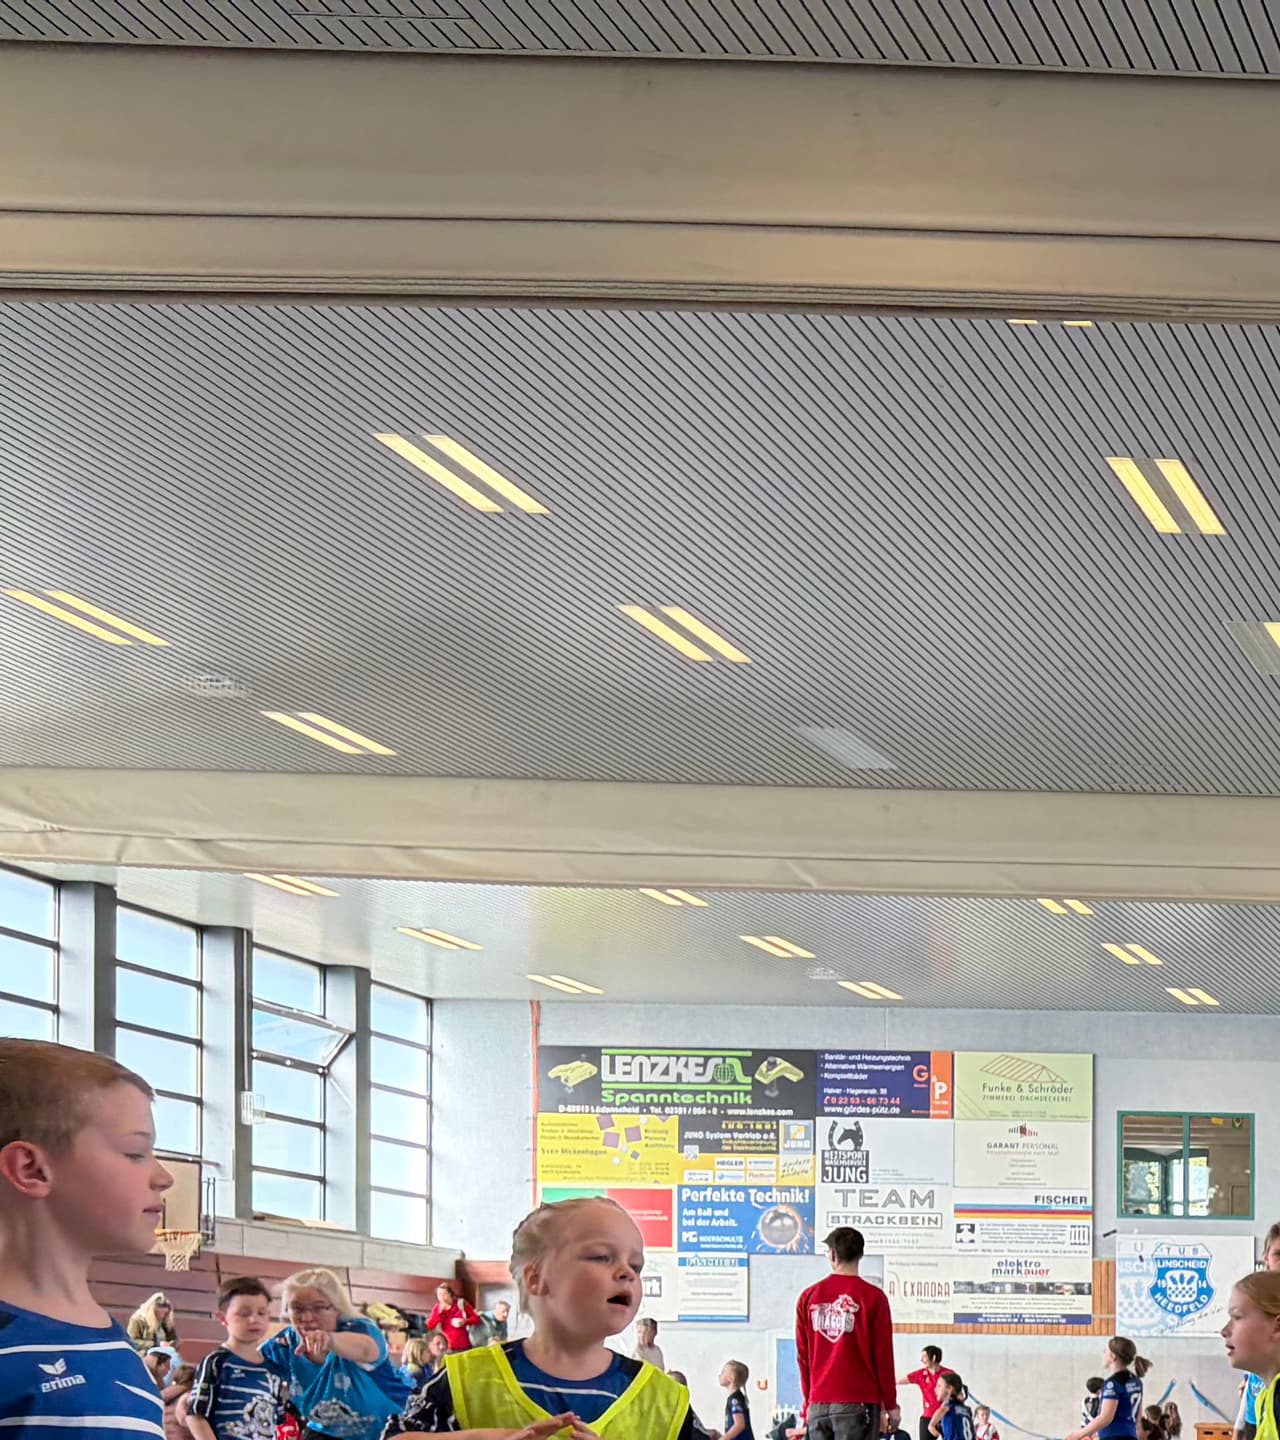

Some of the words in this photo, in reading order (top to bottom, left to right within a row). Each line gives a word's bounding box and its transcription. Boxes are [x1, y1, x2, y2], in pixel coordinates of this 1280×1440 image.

[602, 1054, 722, 1084] LENZKES
[912, 1064, 929, 1083] G
[934, 1081, 948, 1100] P
[982, 1082, 1012, 1094] Funke
[1016, 1084, 1024, 1094] &
[1028, 1082, 1073, 1095] Schröder
[601, 1090, 753, 1106] Spanntechnik
[986, 1142, 1020, 1150] GARANT
[823, 1166, 867, 1183] JUNG
[681, 1188, 746, 1203] Perfekte
[747, 1188, 810, 1206] Technik!
[834, 1188, 935, 1209] TEAM
[1034, 1195, 1088, 1205] FISCHER
[682, 1208, 696, 1217] Am
[831, 1214, 939, 1226] STRACKBEIN
[997, 1259, 1041, 1268] elektro
[1157, 1260, 1207, 1269] LINSCHEID
[992, 1266, 1051, 1277] markauer
[1154, 1291, 1209, 1314] HEEDFELD
[40, 1374, 87, 1393] erima
